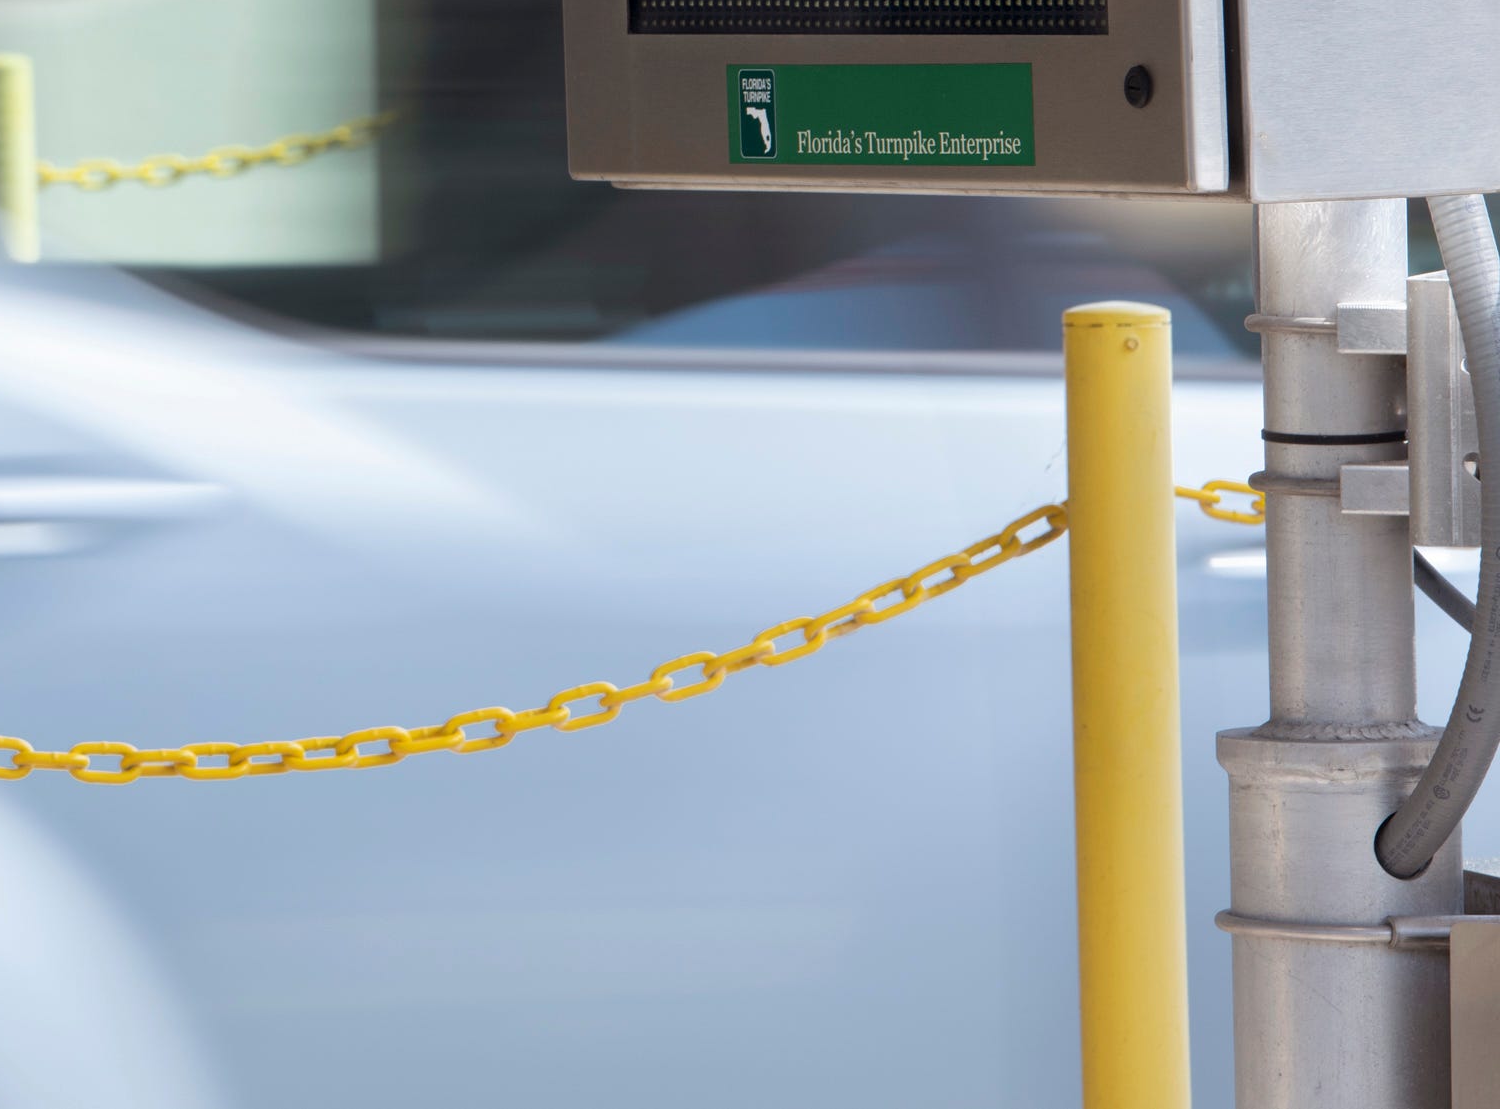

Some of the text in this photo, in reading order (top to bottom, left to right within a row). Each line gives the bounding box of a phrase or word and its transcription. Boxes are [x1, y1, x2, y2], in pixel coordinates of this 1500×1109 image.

[742, 78, 771, 90] FLORIDA'S
[743, 91, 771, 103] TURNPIKE
[797, 129, 1022, 161] Florida's Turnpike Enterprise
